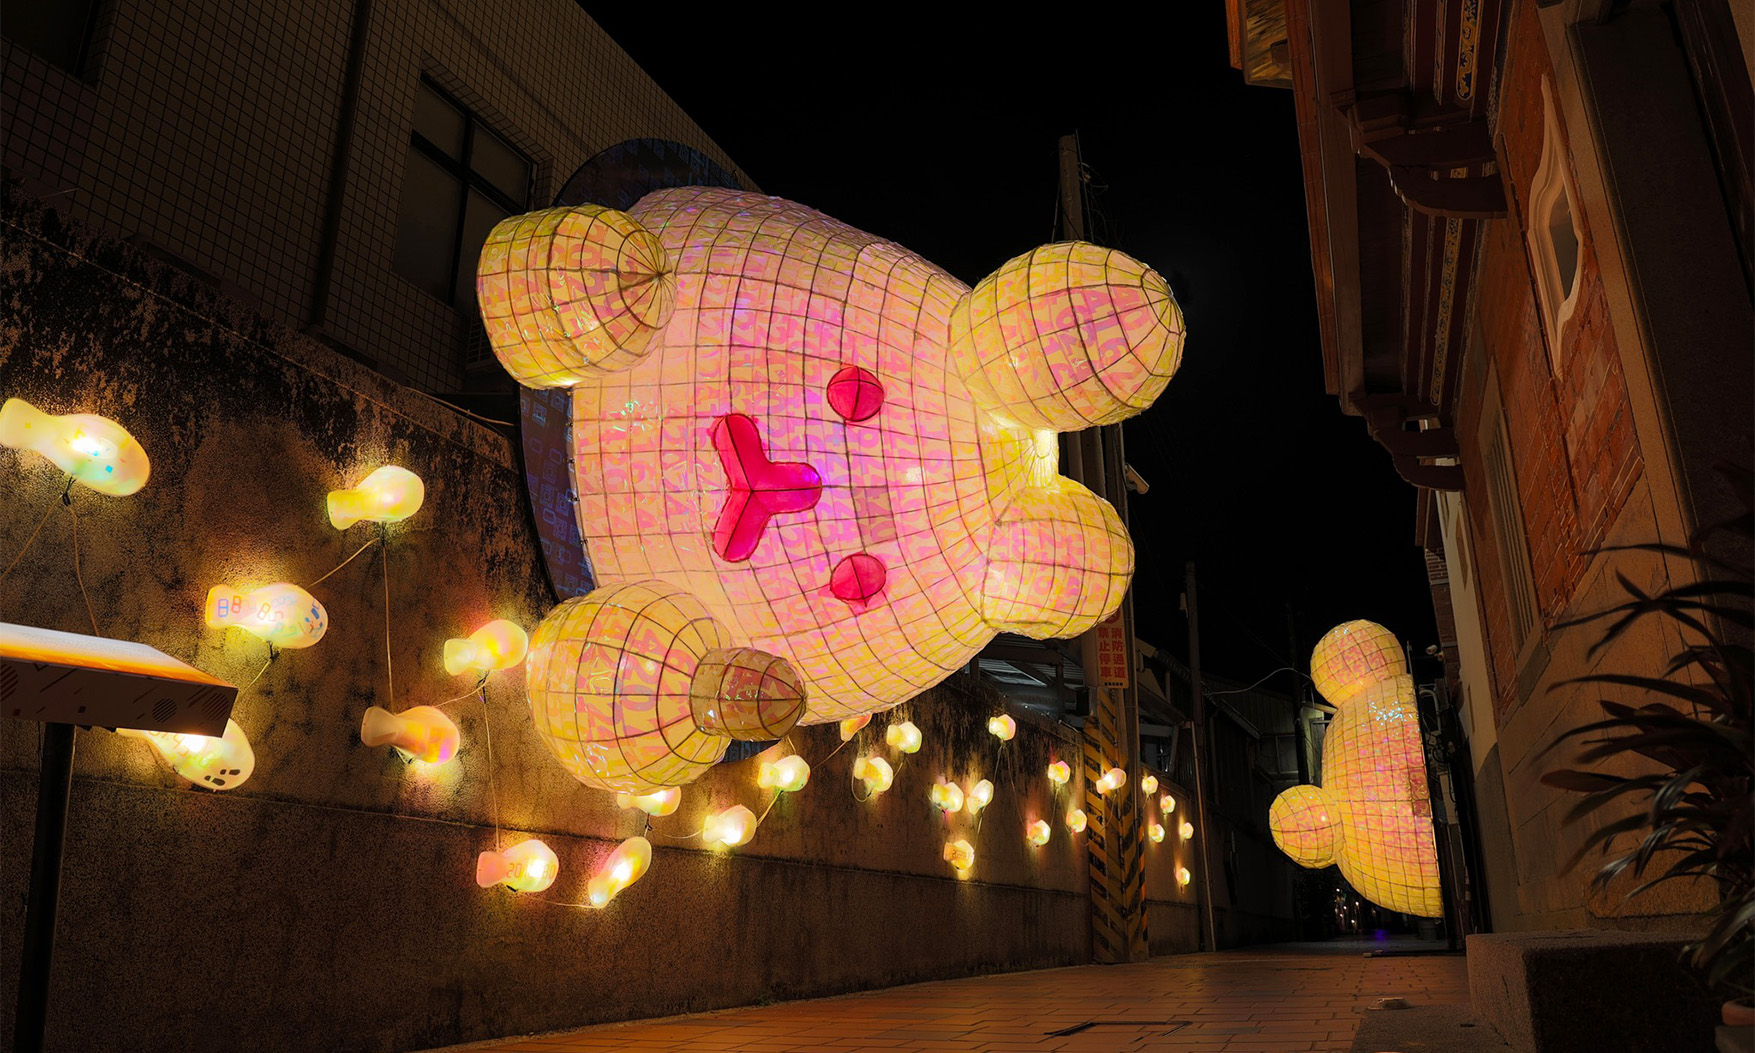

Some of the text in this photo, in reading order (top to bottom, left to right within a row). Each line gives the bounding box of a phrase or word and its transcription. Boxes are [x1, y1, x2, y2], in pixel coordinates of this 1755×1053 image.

[1097, 627, 1113, 679] 禁止停車
[1111, 627, 1126, 679] 消防通道
